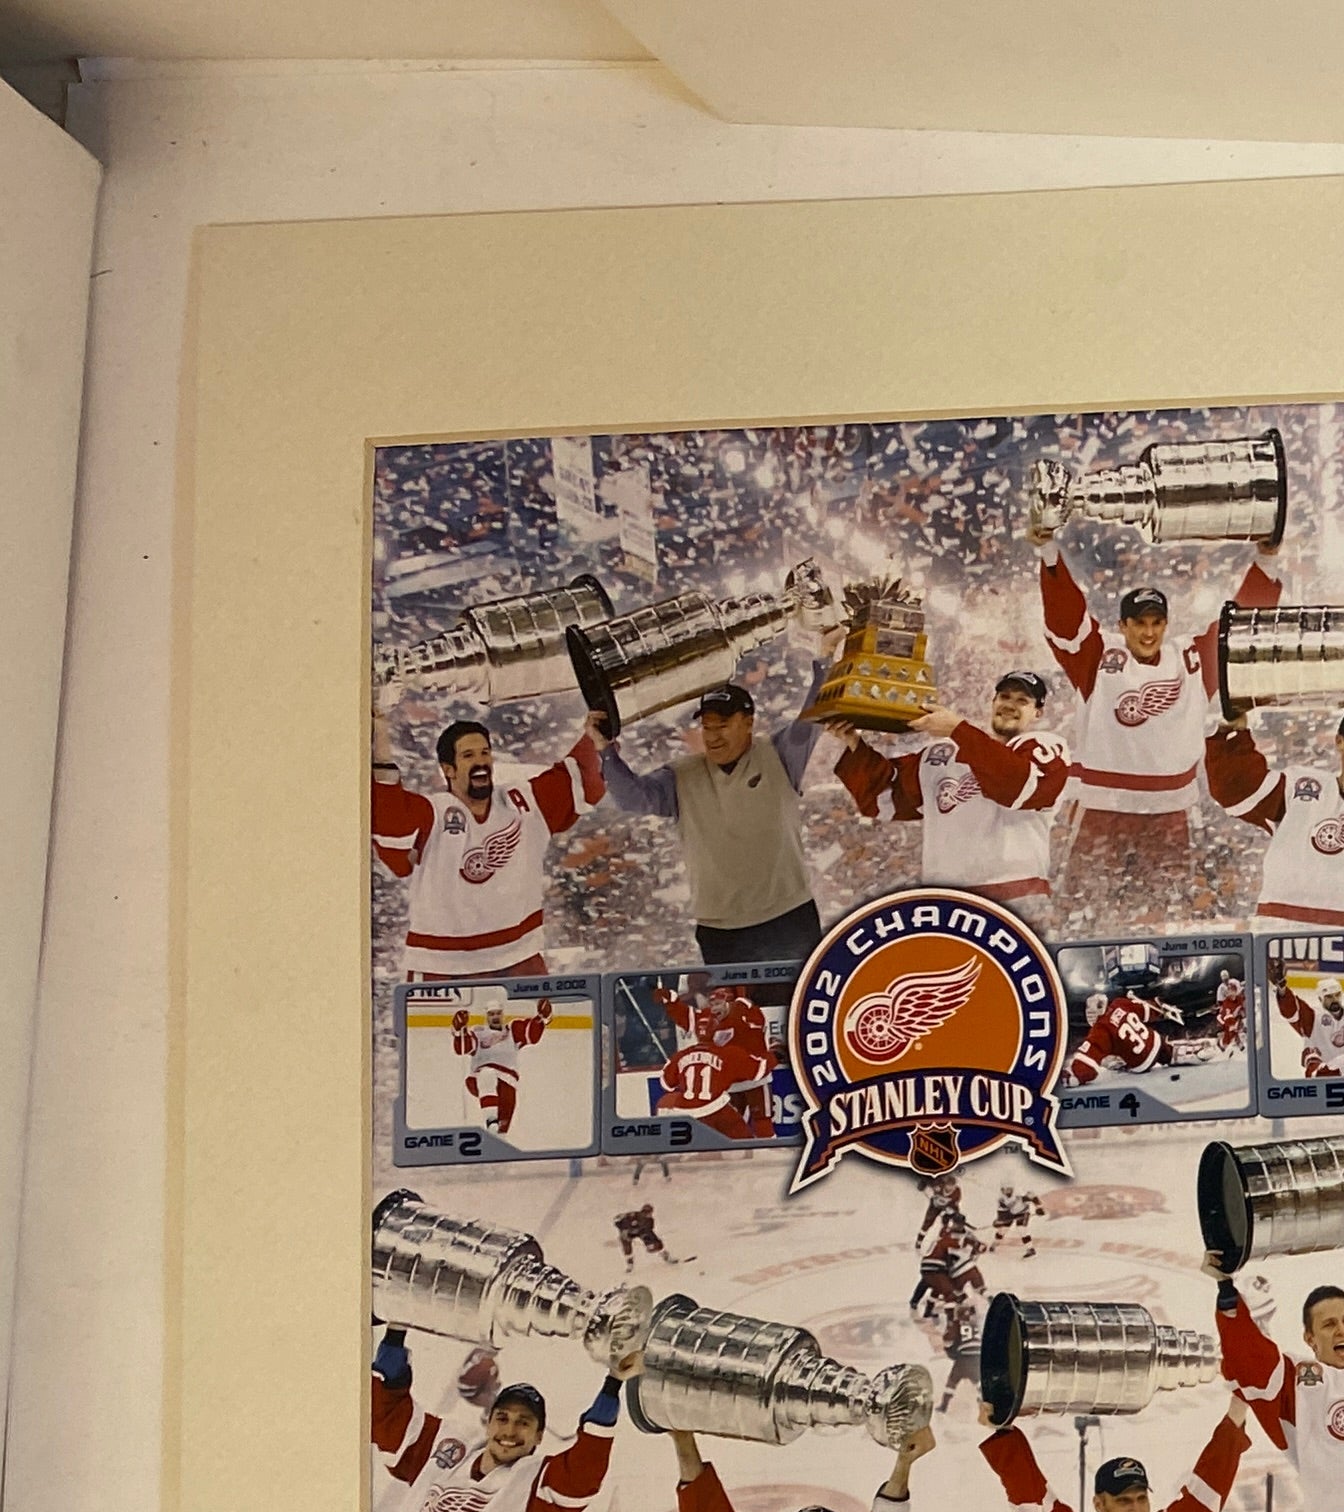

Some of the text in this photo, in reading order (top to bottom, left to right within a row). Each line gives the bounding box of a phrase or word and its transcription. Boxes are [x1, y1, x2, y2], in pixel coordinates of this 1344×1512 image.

[507, 788, 530, 815] A
[1162, 938, 1243, 951] June 10, 2002
[513, 983, 539, 993] June
[556, 979, 587, 990] 2002
[721, 968, 747, 980] June
[806, 905, 1051, 1086] 2002 CHAMPIONS
[1118, 1012, 1150, 1055] 39
[683, 1065, 712, 1100] 11
[1267, 1085, 1318, 1100] GAME
[829, 1075, 1034, 1137] STANLEY CUP
[1061, 1093, 1140, 1117] GAME 4
[404, 1132, 482, 1156] GAME 2
[611, 1121, 692, 1146] GAME 3
[919, 1136, 949, 1165] NHL
